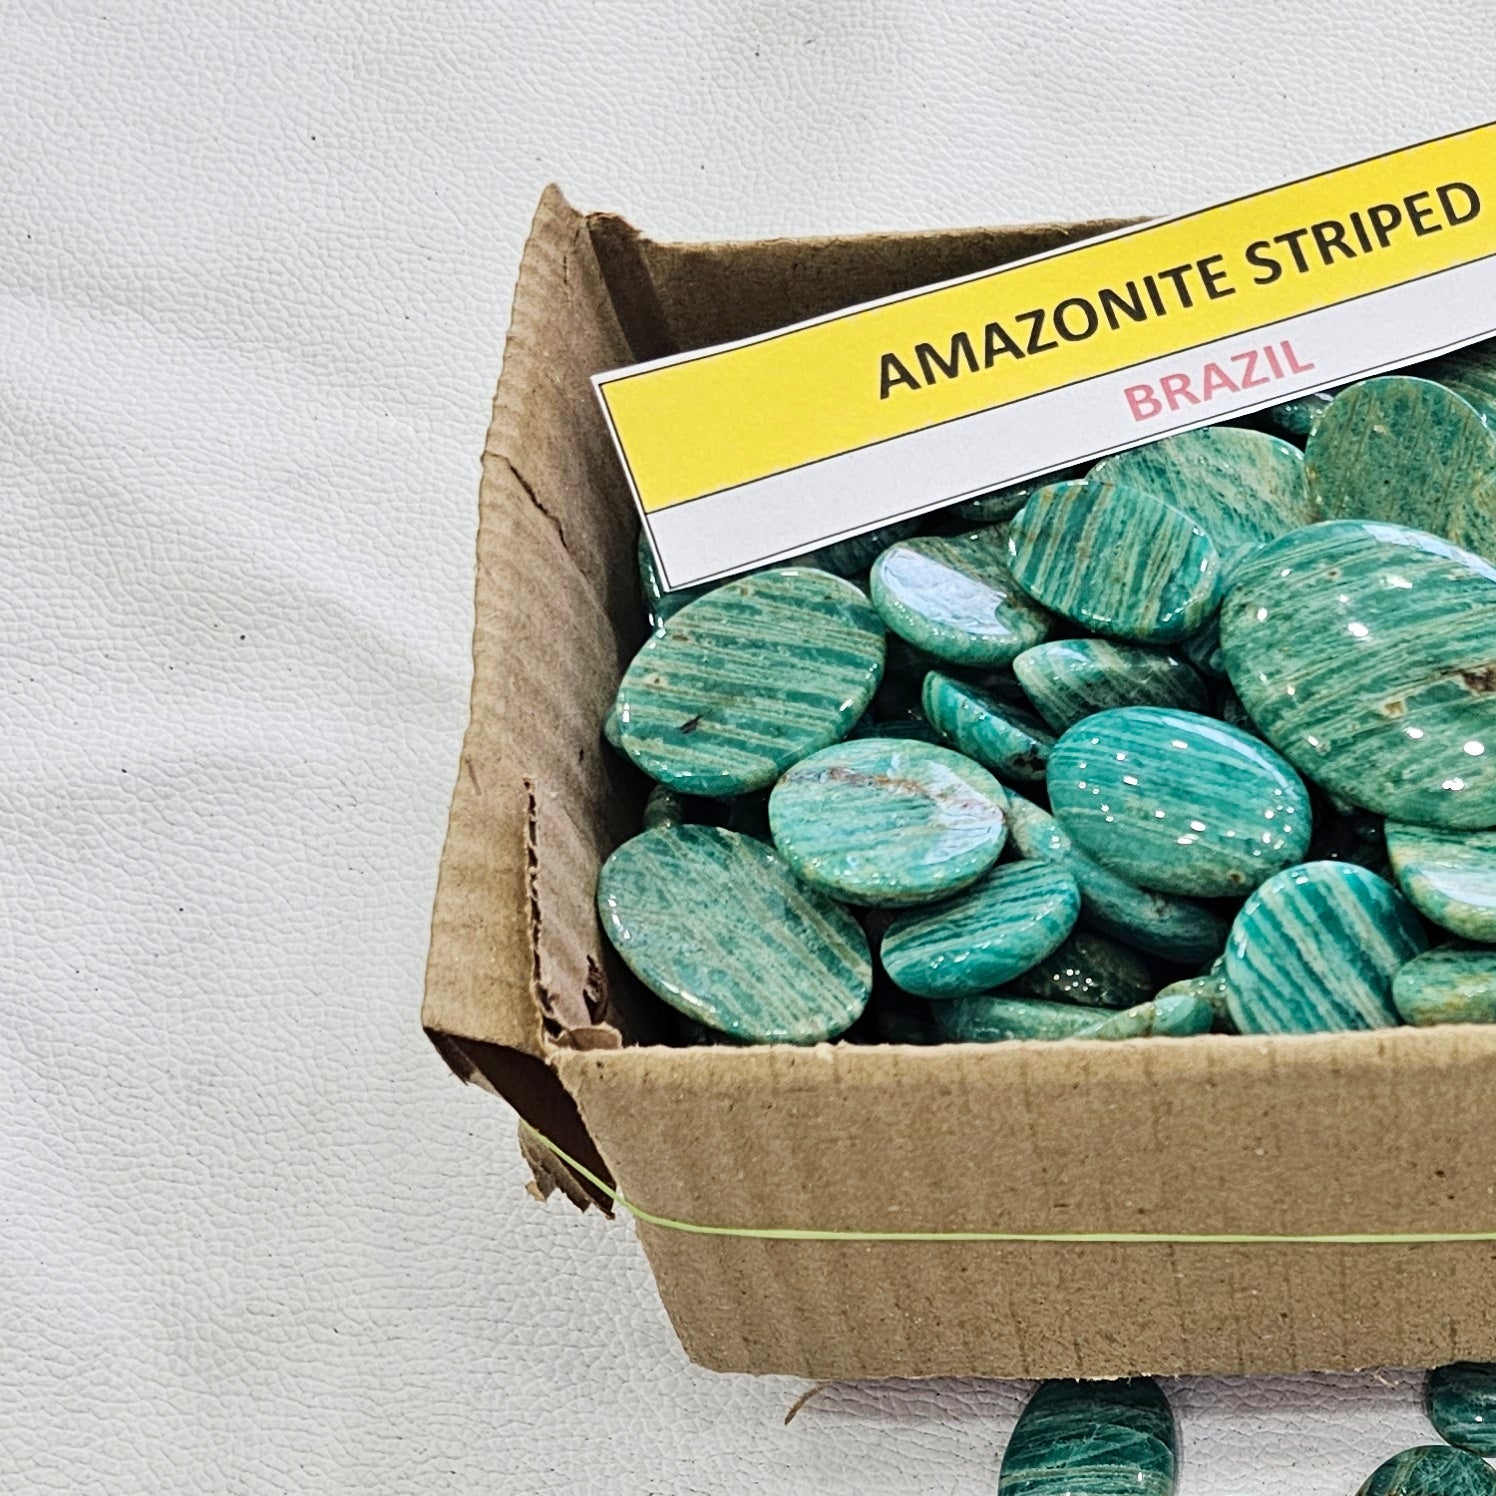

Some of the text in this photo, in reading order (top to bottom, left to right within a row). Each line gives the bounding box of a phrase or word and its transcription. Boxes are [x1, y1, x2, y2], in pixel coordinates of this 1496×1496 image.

[880, 182, 1482, 400] AMAZONITE STRIPED
[1124, 339, 1315, 422] BRAZIL
